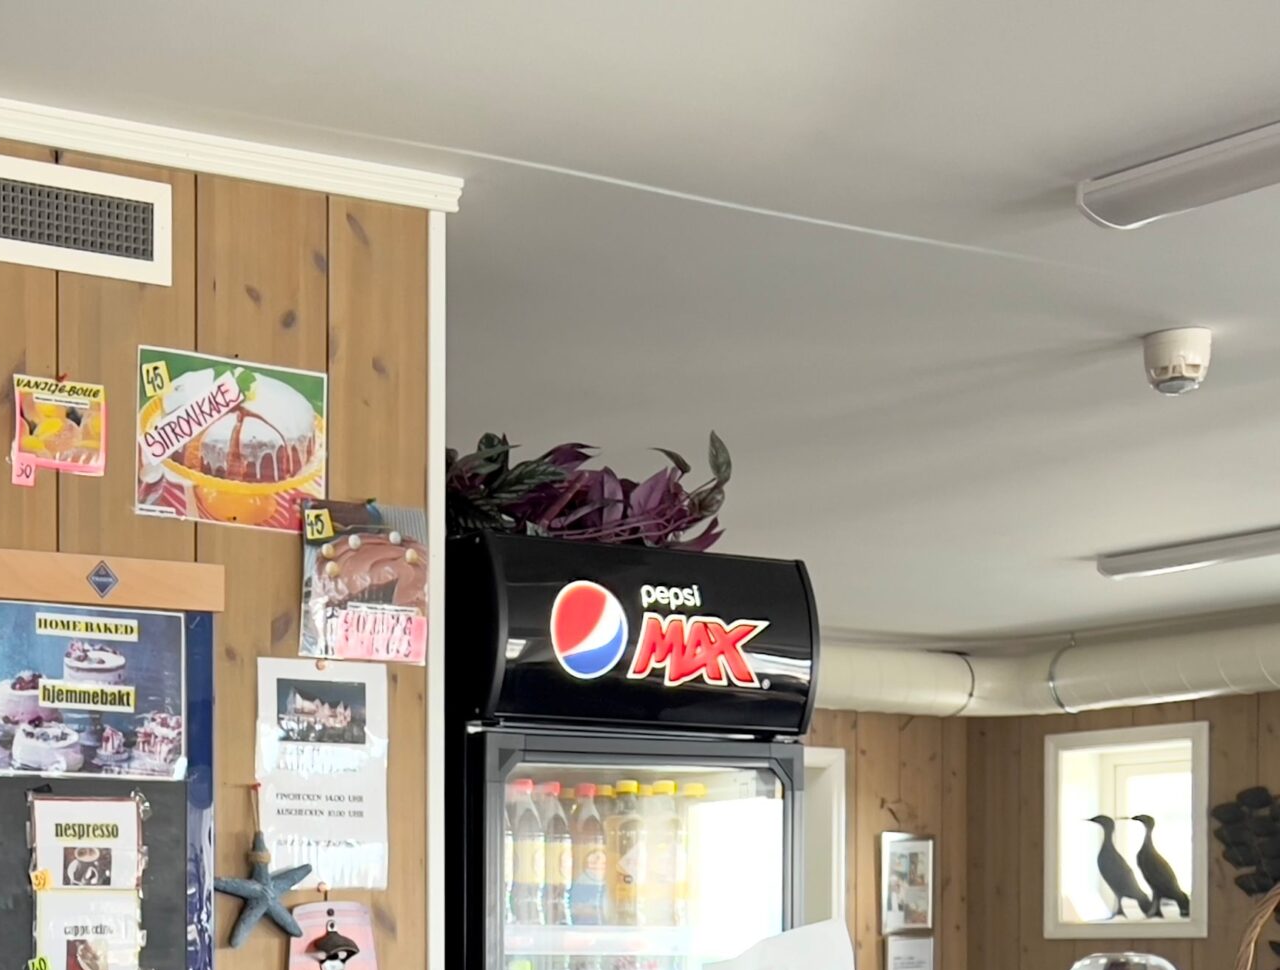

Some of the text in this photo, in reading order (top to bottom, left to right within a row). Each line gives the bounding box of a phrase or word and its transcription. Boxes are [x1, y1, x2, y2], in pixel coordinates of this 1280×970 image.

[146, 367, 165, 392] 45
[144, 384, 241, 458] SITRONKAKE
[306, 513, 325, 537] 45
[640, 584, 702, 610] pepsi
[38, 617, 134, 636] HOME BAKED
[627, 612, 770, 688] MAX
[42, 685, 132, 707] hjemmebakt
[55, 823, 119, 840] nespresso
